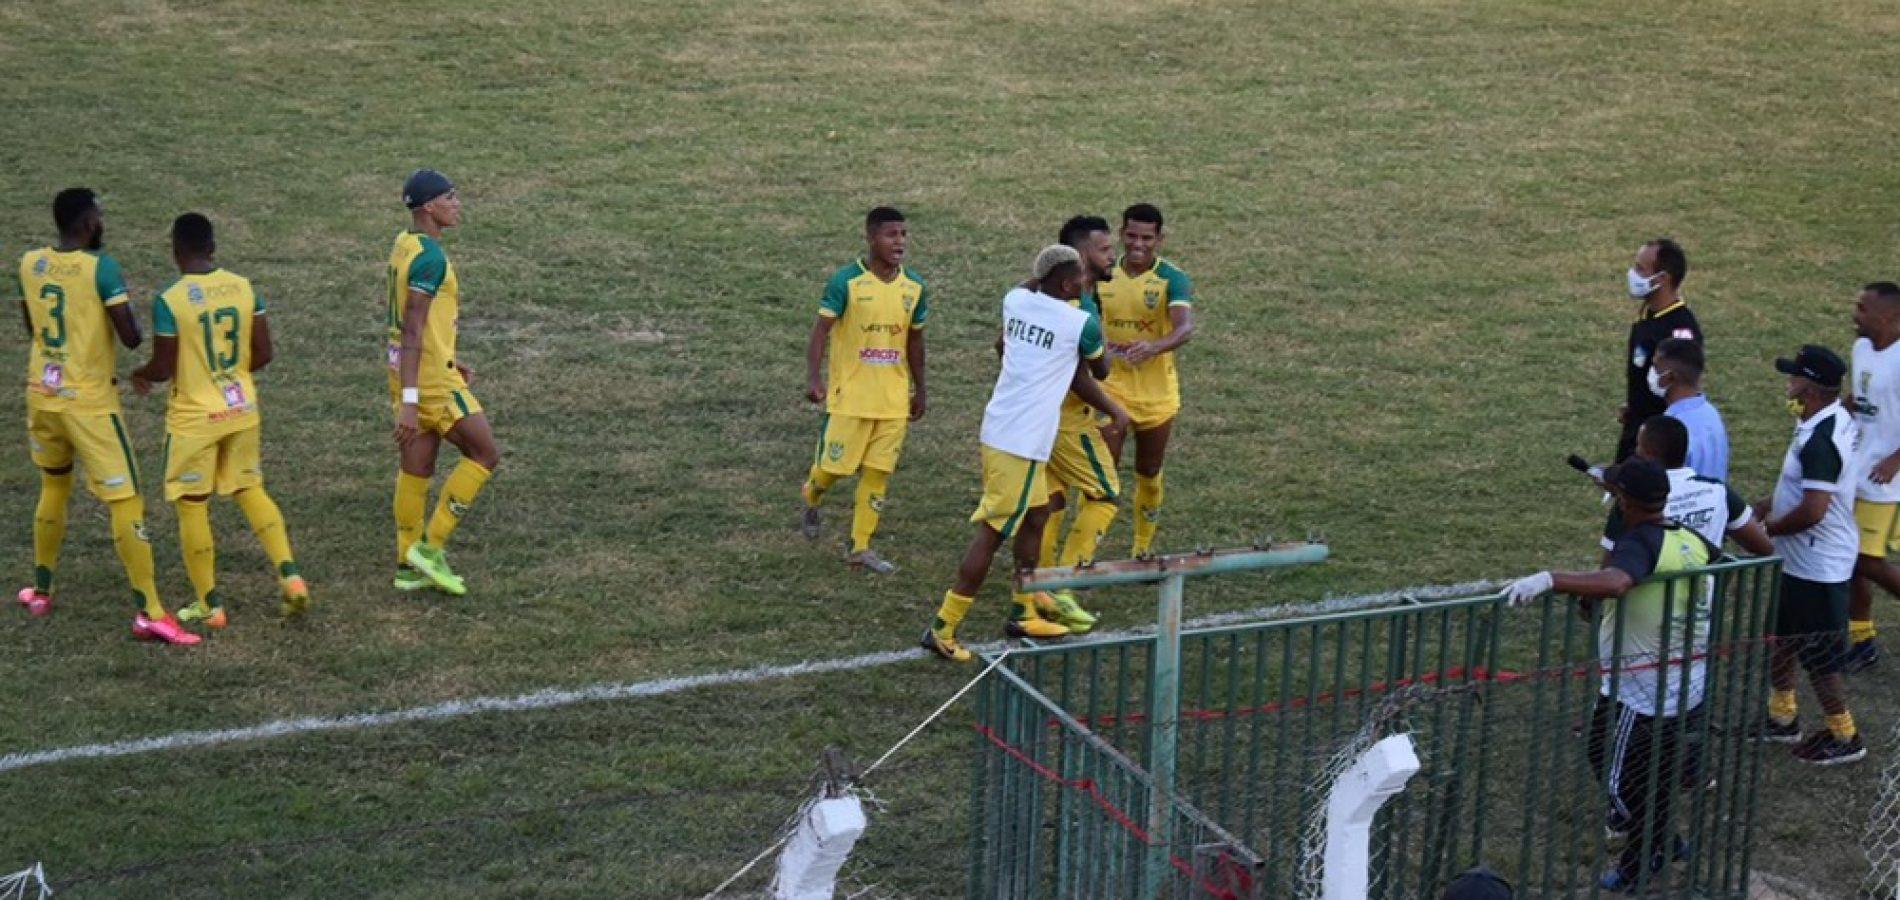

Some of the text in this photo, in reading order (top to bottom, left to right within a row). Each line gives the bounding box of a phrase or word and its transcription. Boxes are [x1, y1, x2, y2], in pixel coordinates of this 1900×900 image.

[40, 284, 66, 348] 3
[198, 306, 240, 371] 13
[1007, 317, 1055, 350] ATLETA
